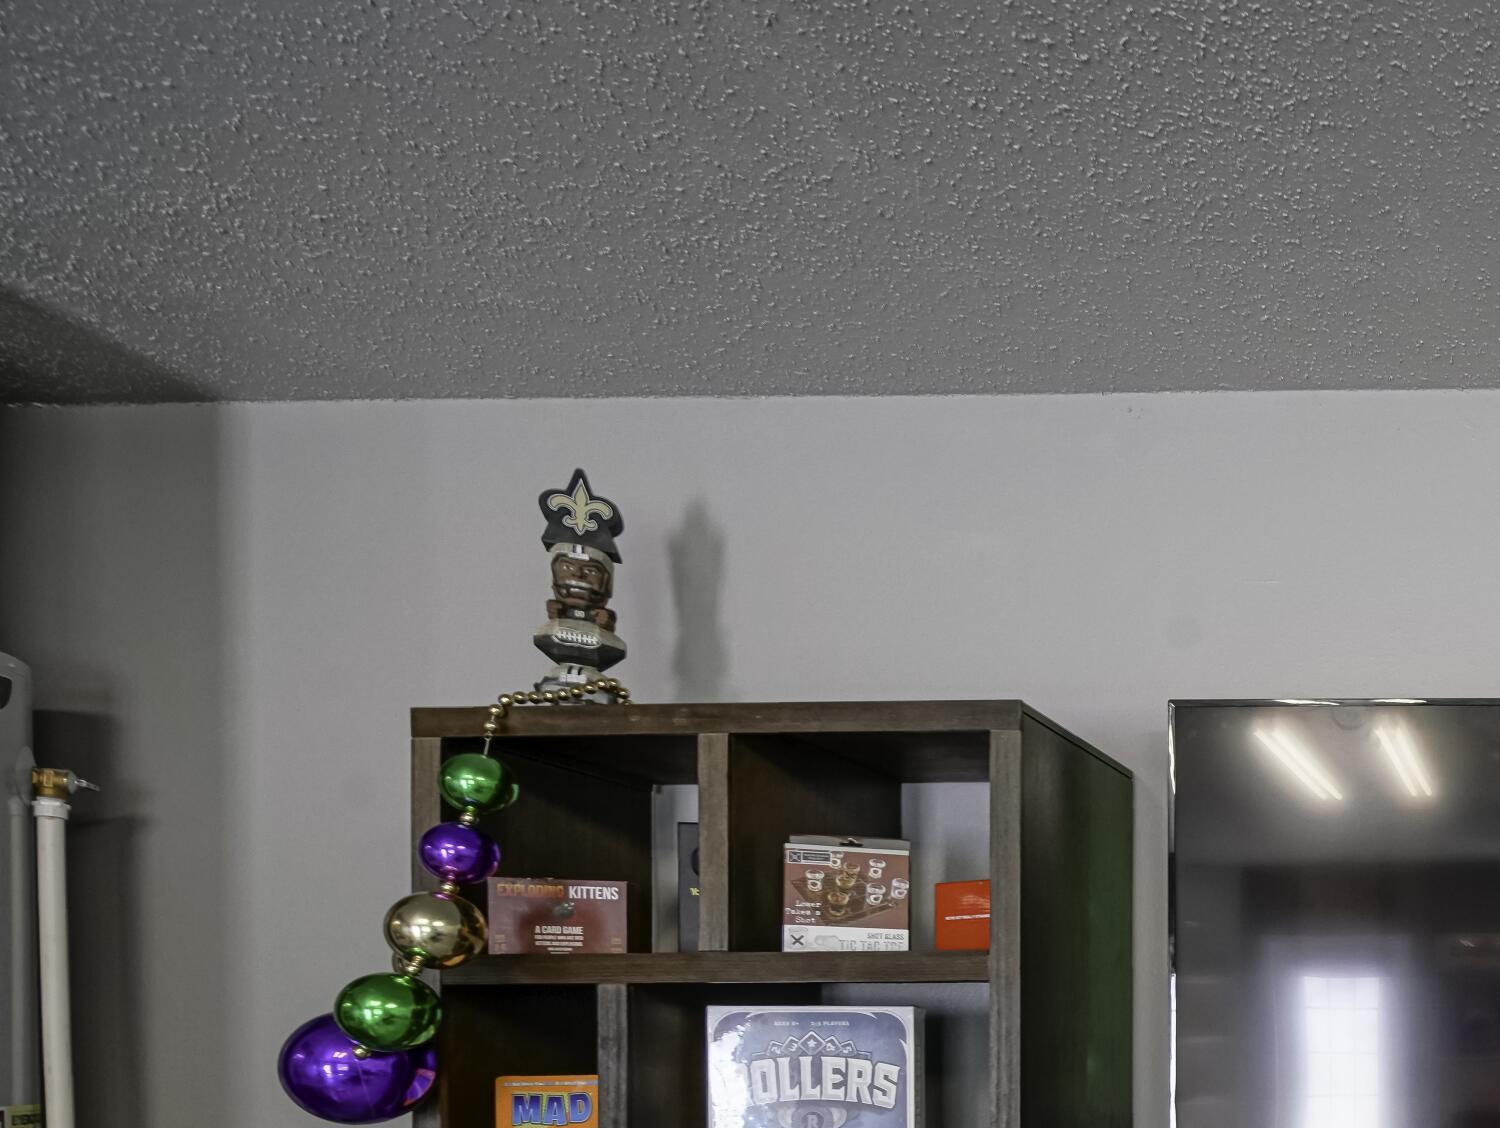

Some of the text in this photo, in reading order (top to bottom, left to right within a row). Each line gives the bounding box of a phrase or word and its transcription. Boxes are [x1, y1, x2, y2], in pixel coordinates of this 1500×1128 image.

[568, 885, 619, 900] KITTENS
[535, 925, 584, 934] A CARD GAME
[788, 1043, 798, 1052] 3
[744, 1056, 901, 1109] OLLERS
[512, 1091, 593, 1126] MAD
[806, 1115, 818, 1128] R
